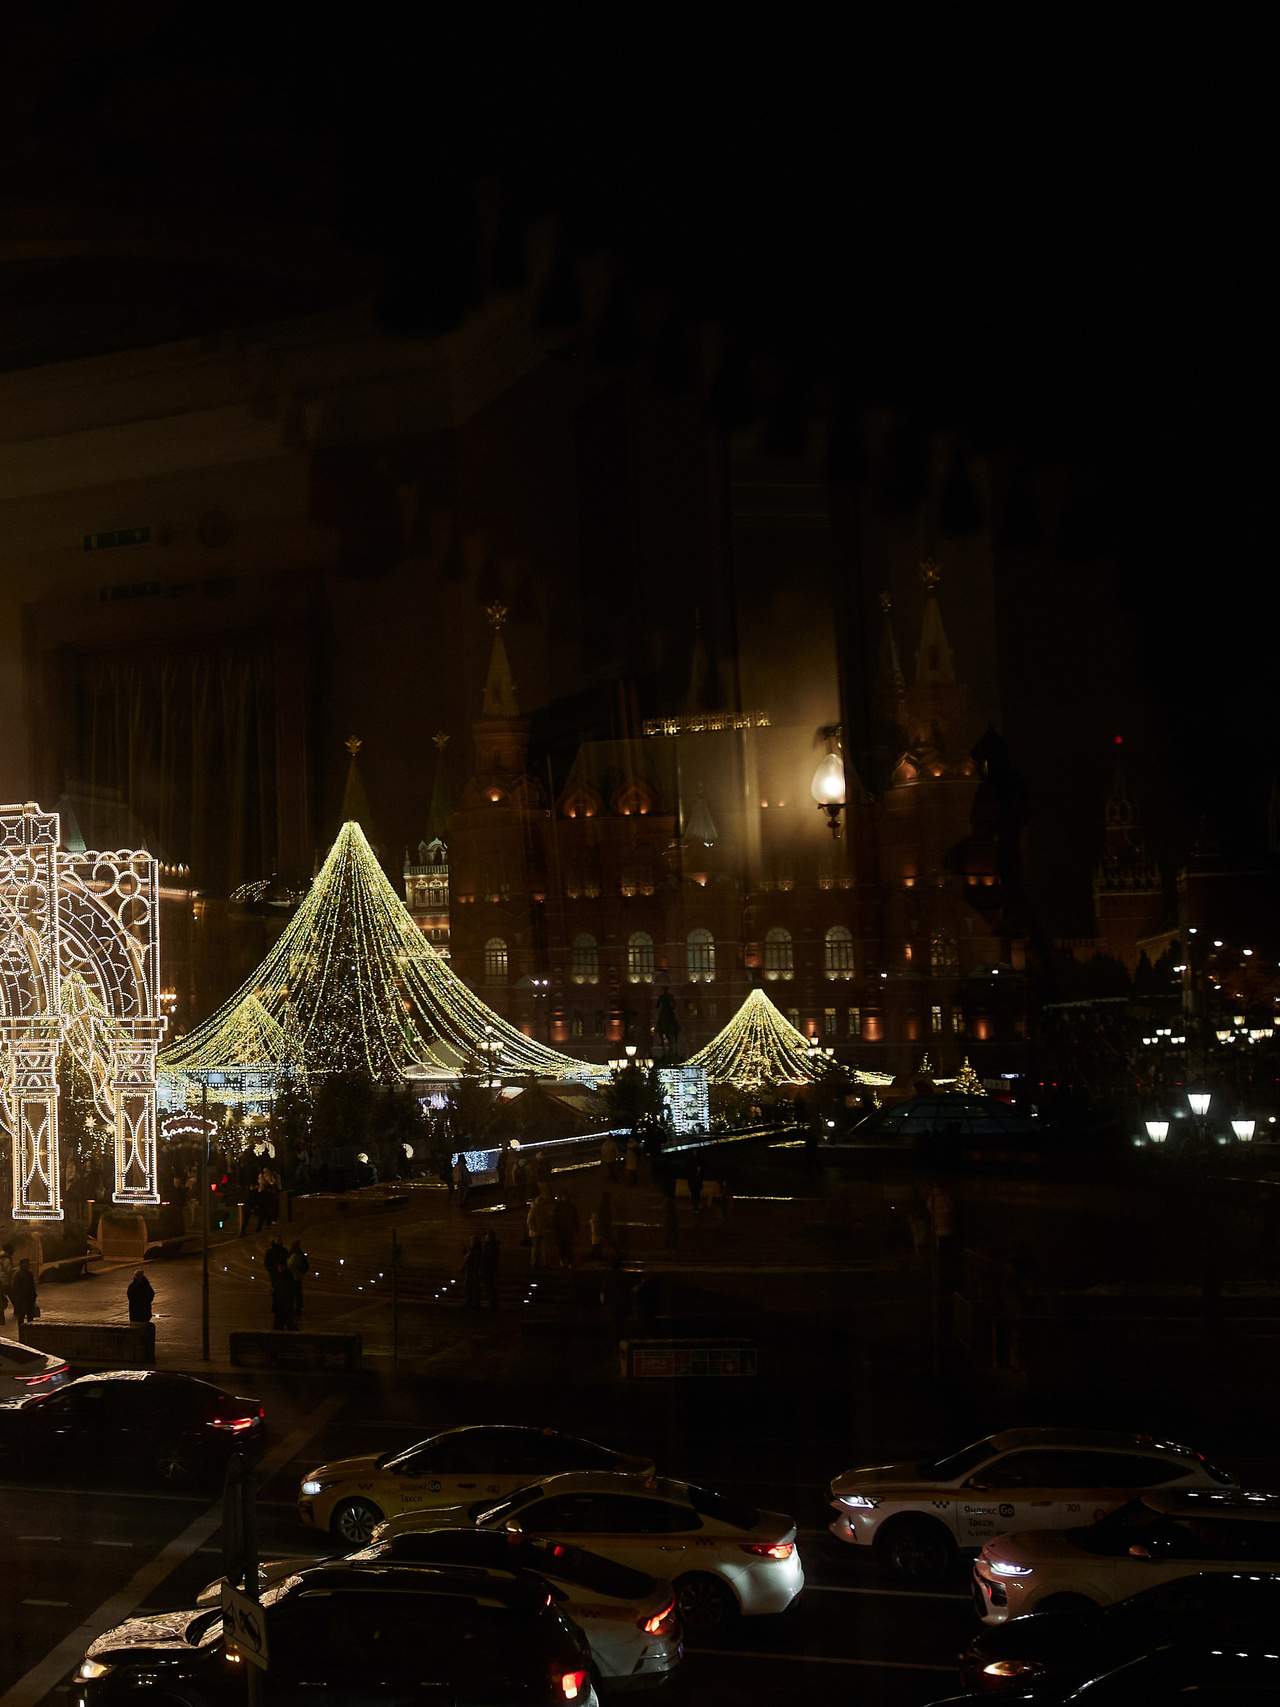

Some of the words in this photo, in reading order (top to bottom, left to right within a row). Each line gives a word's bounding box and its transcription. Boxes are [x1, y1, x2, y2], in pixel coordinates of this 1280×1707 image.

[400, 1483, 428, 1492] Яндекс
[429, 1481, 441, 1491] Go
[400, 1494, 422, 1503] Такси
[964, 1506, 997, 1515] Яндекс
[1001, 1505, 1014, 1515] Go
[1066, 1504, 1080, 1512] 701
[969, 1518, 994, 1527] Такси
